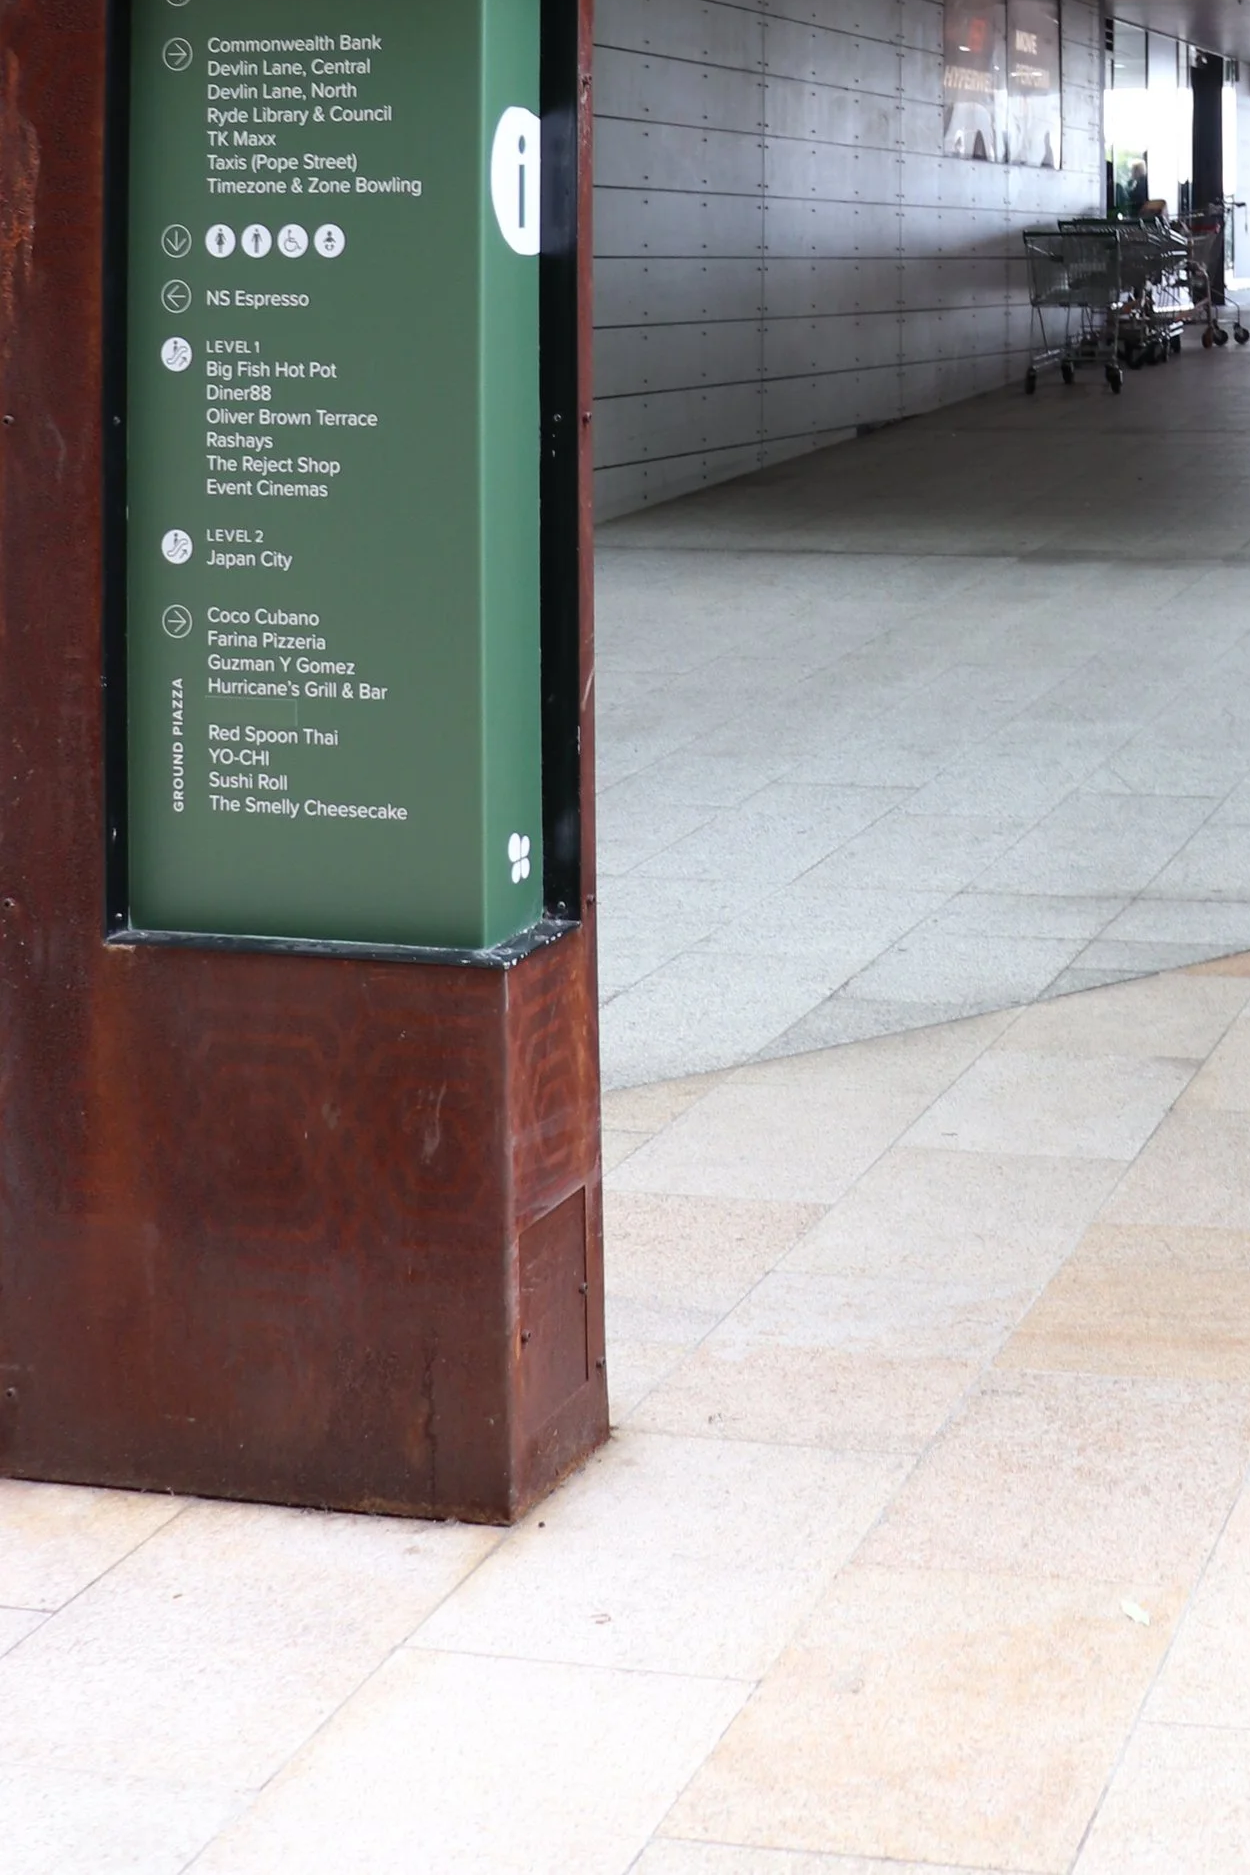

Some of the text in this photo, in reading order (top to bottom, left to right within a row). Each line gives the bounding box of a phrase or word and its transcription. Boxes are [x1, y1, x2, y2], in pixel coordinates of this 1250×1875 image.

[207, 34, 382, 54] Commonwealth Bank
[207, 57, 371, 77] Devlin Lane, Central
[207, 82, 357, 101] Devlin Lane, North
[207, 105, 392, 128] Ryde Library & Council
[206, 130, 277, 147] TK Maxx
[206, 152, 358, 174] Taxis (Pope Street)
[206, 176, 422, 197] Timezone & Zone Bowling
[206, 289, 310, 310] NS Espresso
[206, 340, 260, 354] LEVEL 1
[206, 360, 338, 381] Big Fish Hot Pot
[206, 384, 272, 402] Diner88
[206, 407, 378, 427] Oliver Brown Terrace
[206, 431, 274, 453] Rashays
[205, 454, 341, 477] The Reject Shop
[206, 478, 329, 498] Event Cinemas
[206, 528, 264, 544] LEVEL 2
[206, 549, 293, 572] Japan City
[206, 606, 320, 627] Coco Cubano
[207, 629, 326, 651] Farina Pizzeria
[207, 653, 356, 675] Guzman Y Gomez
[208, 677, 388, 700] Hurricane's Grill & Bar
[171, 677, 185, 813] GROUND PIAZZA
[208, 724, 339, 746] Red Spoon Thai
[208, 747, 270, 767] YO-CHI
[208, 771, 288, 791] Sushi Roll
[208, 794, 408, 821] The Smelly Cheesecake
